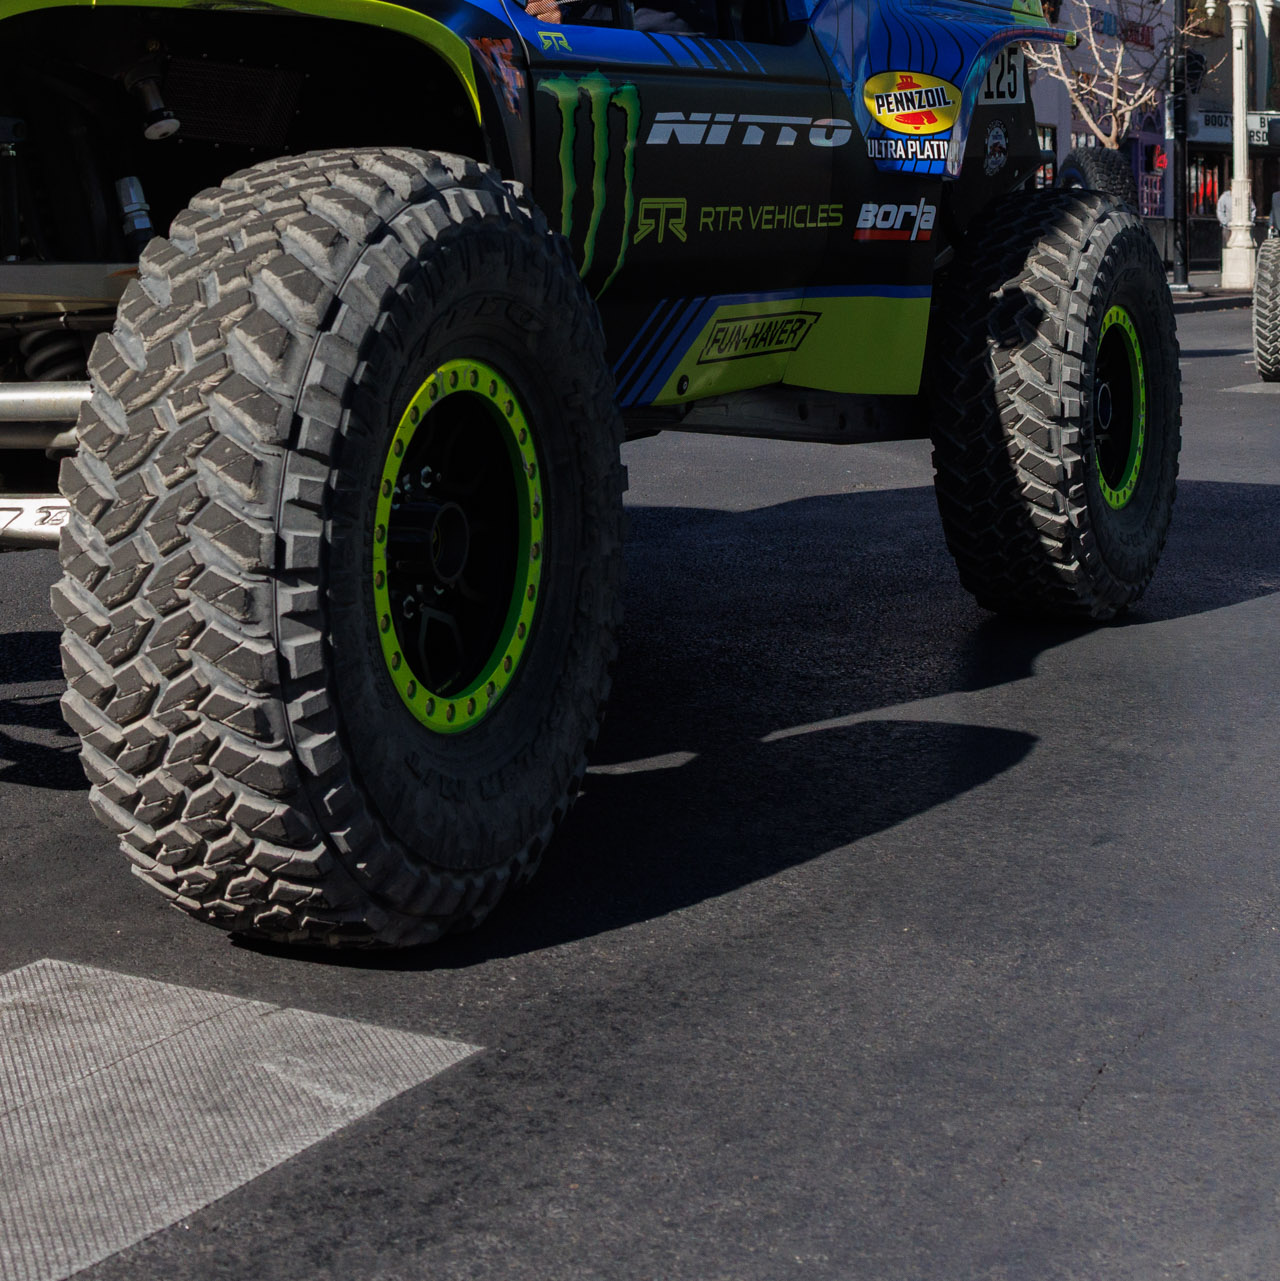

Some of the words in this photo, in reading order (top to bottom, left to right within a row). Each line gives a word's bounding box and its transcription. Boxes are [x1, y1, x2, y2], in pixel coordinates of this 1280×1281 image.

[983, 47, 1018, 99] 125
[874, 86, 952, 115] PENNZOIL
[646, 112, 853, 147] NITTO
[867, 138, 906, 159] ULTRA
[699, 206, 744, 231] RTR
[748, 204, 844, 230] VEHICLES
[706, 318, 806, 356] FUN-HAVER
